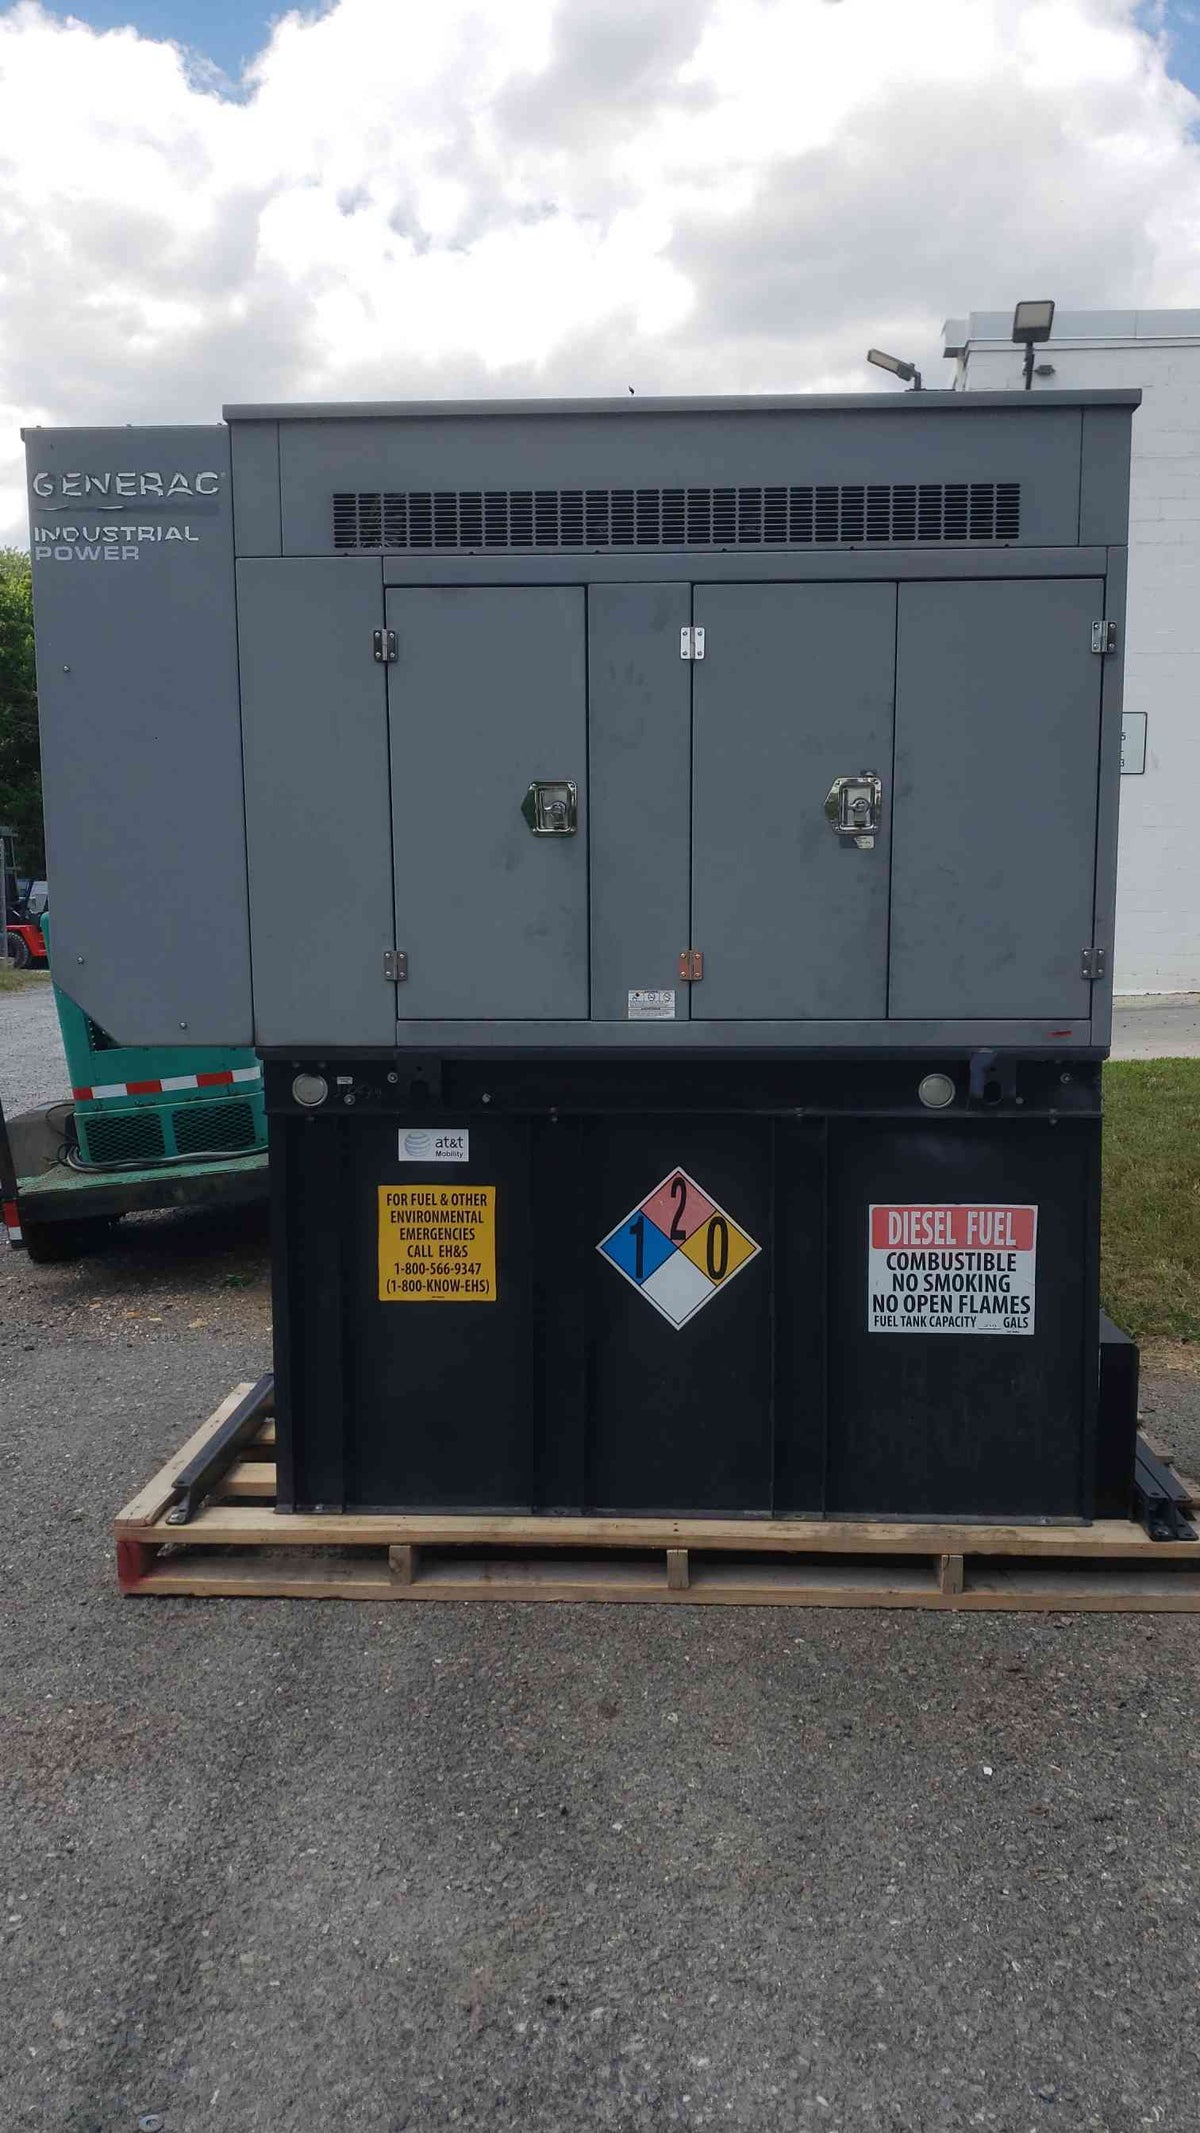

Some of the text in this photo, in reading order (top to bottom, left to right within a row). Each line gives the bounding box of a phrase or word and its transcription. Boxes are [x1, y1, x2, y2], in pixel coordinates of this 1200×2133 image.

[32, 471, 220, 497] GENERAC
[34, 526, 199, 542] INDUSTRIAL
[35, 545, 139, 561] POWER
[435, 1136, 463, 1148] at&t
[387, 1193, 487, 1206] FOR FUEL & OTHER
[670, 1177, 687, 1240] 2
[391, 1211, 484, 1224] ENVIRONMENTAL
[400, 1228, 475, 1241] EMERGENCIES
[888, 1211, 1016, 1246] DIESEL FUEL
[407, 1245, 468, 1257] CALL EH&S
[630, 1216, 644, 1278] 1
[707, 1216, 728, 1280] 0
[394, 1263, 481, 1275] 1-800-566-9347
[887, 1252, 1016, 1272] COMBUSTIBLE
[387, 1280, 490, 1294] (1-800-KNOW-EHS)
[892, 1273, 1010, 1292] NO SMOKING
[873, 1294, 1030, 1314] NO OPEN FLAMES
[874, 1316, 898, 1327] FUEL
[901, 1316, 927, 1327] TANK
[929, 1316, 976, 1328] CAPACITY
[1003, 1317, 1028, 1328] GALS
